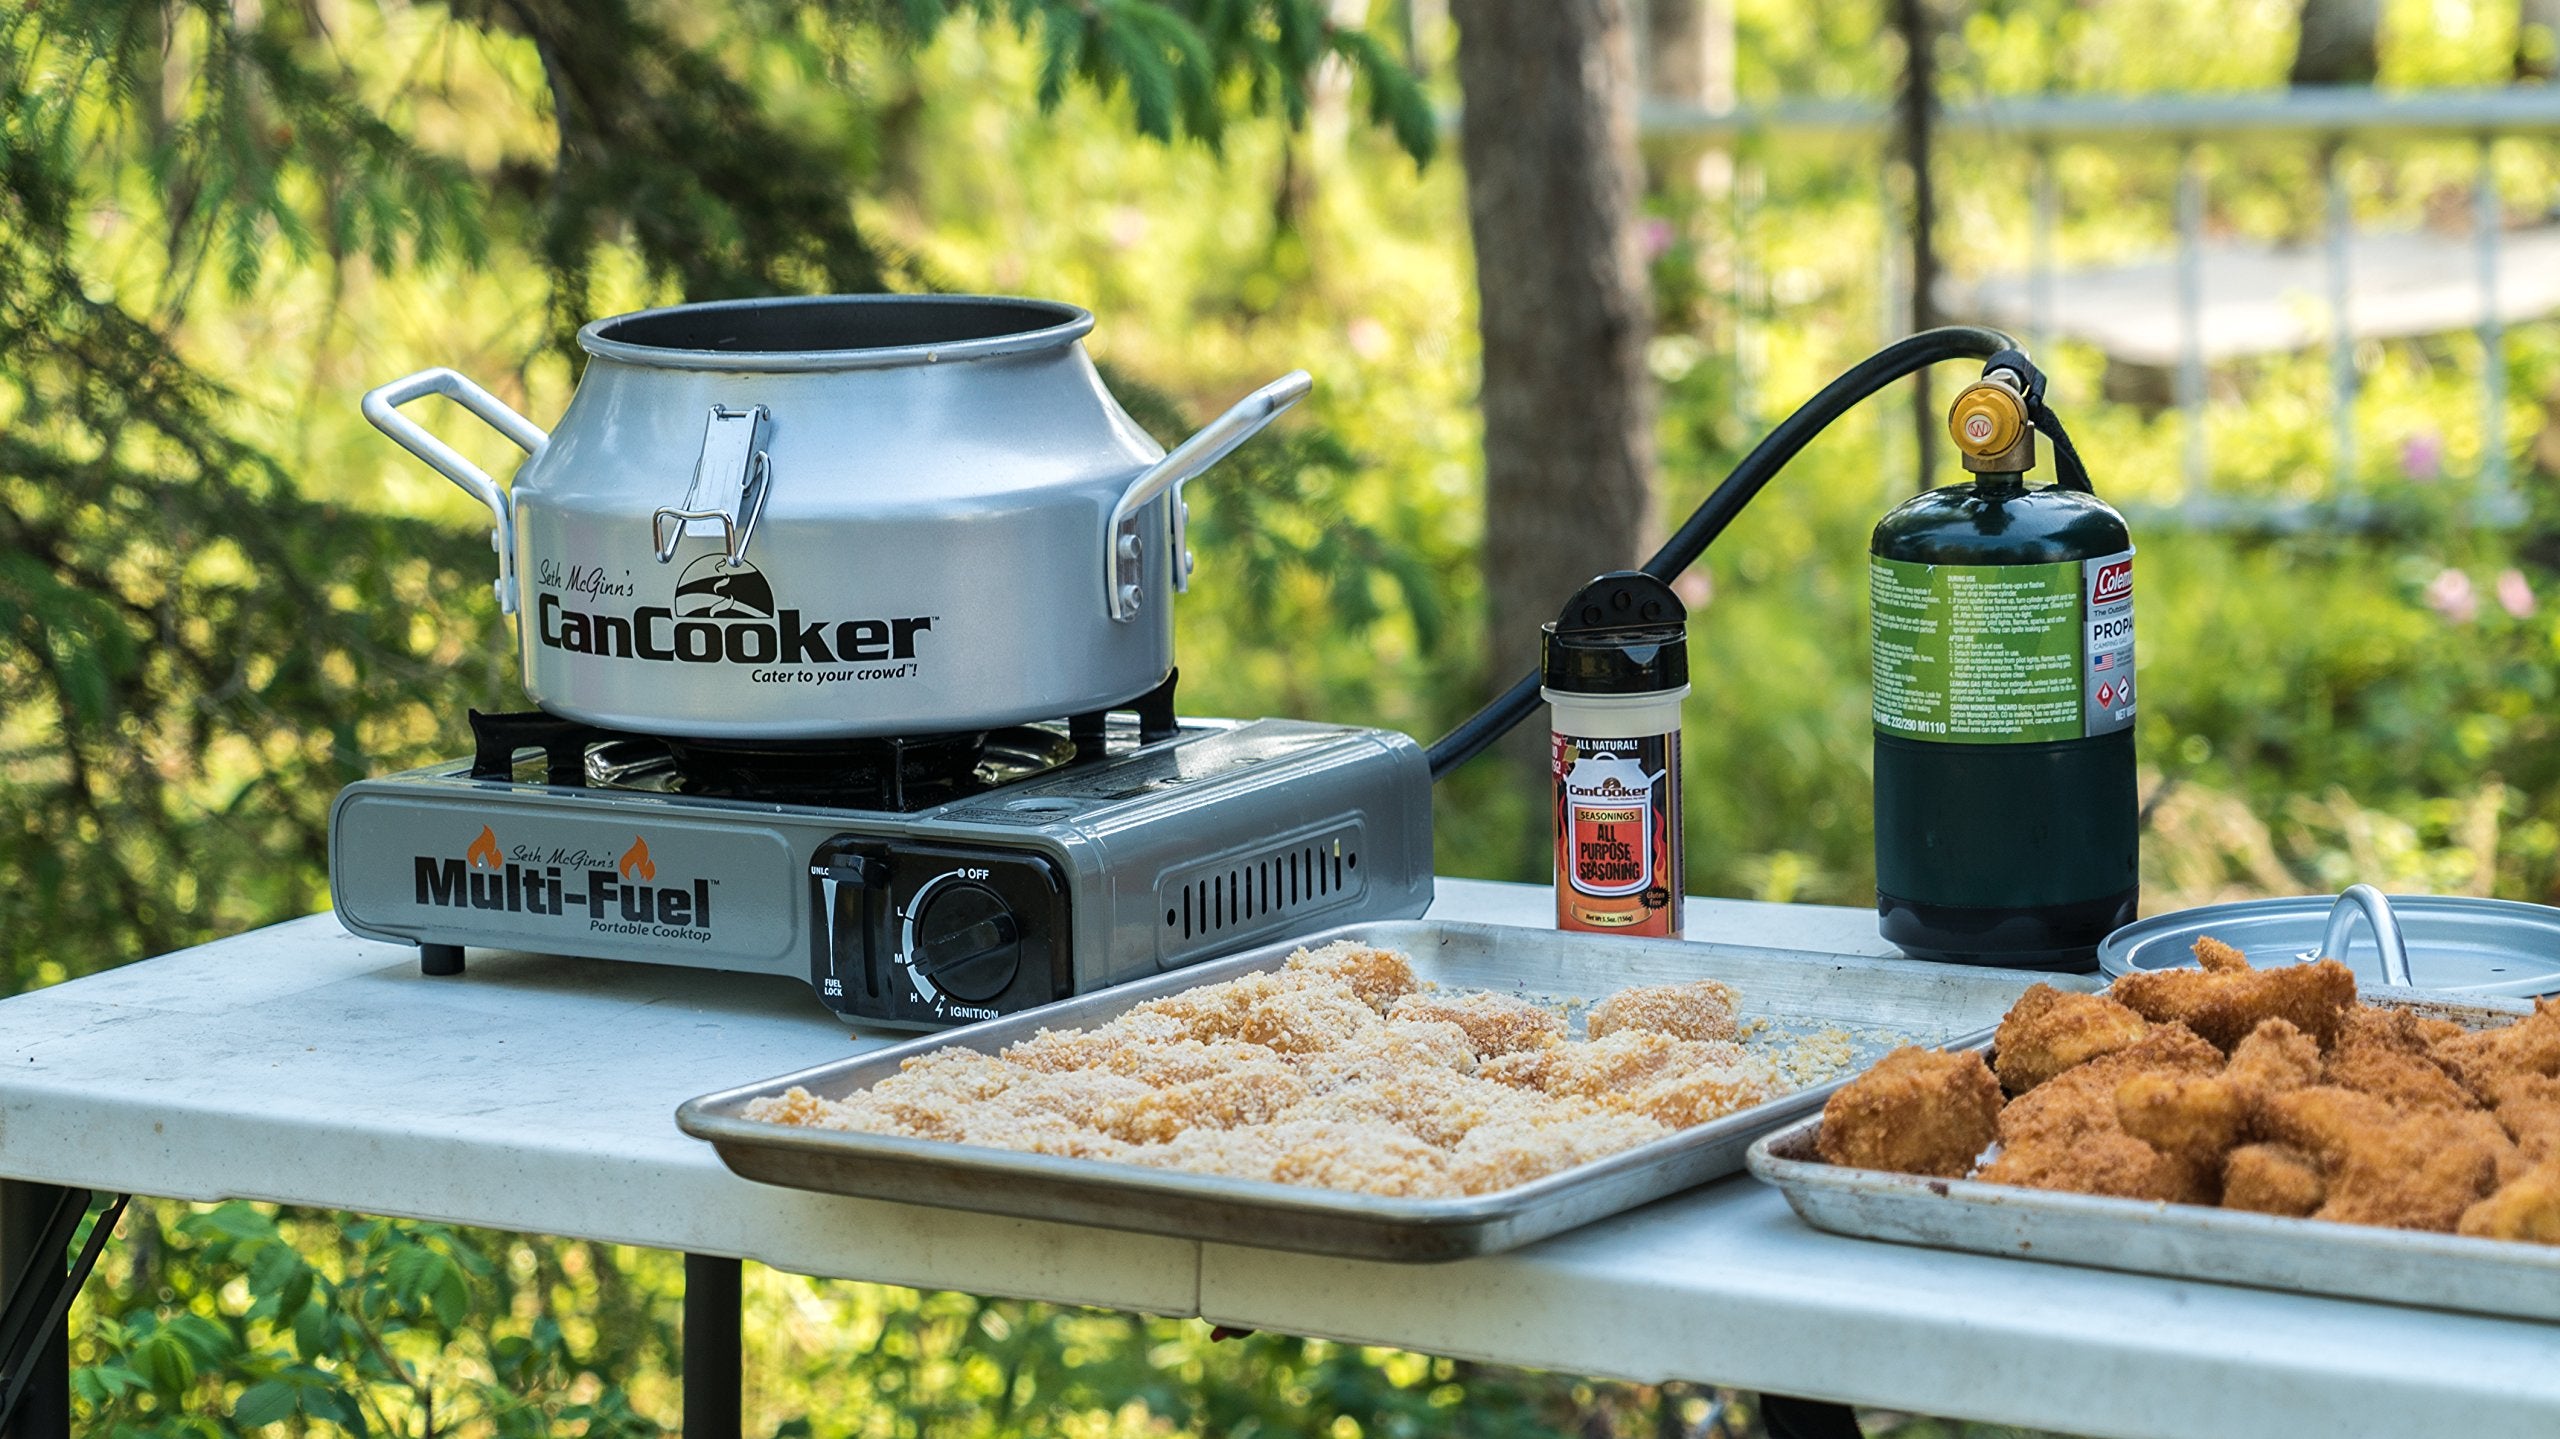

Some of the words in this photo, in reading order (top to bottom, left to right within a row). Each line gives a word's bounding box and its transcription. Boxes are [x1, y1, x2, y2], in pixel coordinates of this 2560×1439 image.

[538, 558, 562, 589] Seth
[565, 565, 634, 603] McGinn's
[2094, 616, 2134, 641] PROPA
[752, 669, 794, 683] Cater
[797, 670, 814, 683] to
[817, 669, 854, 686] your
[1918, 720, 1946, 734] M1110
[1576, 740, 1590, 750] ALL
[1592, 740, 1638, 751] NATURAL!
[1569, 784, 1650, 798] CanCooker
[1580, 812, 1635, 820] SEASONINGS
[1597, 824, 1617, 842] ALL
[508, 845, 542, 863] Seth
[546, 848, 614, 871] McGinn's
[967, 868, 990, 880] OFF
[1580, 862, 1640, 880] SEASONING
[1646, 891, 1665, 899] Gluten
[896, 906, 904, 917] L
[590, 920, 649, 936] Portable
[652, 925, 712, 943] Cooktop
[894, 953, 903, 964] M
[824, 978, 842, 988] FUEL
[824, 987, 842, 997] LOCK
[910, 993, 918, 1003] H
[950, 1006, 999, 1020] IGNITION
